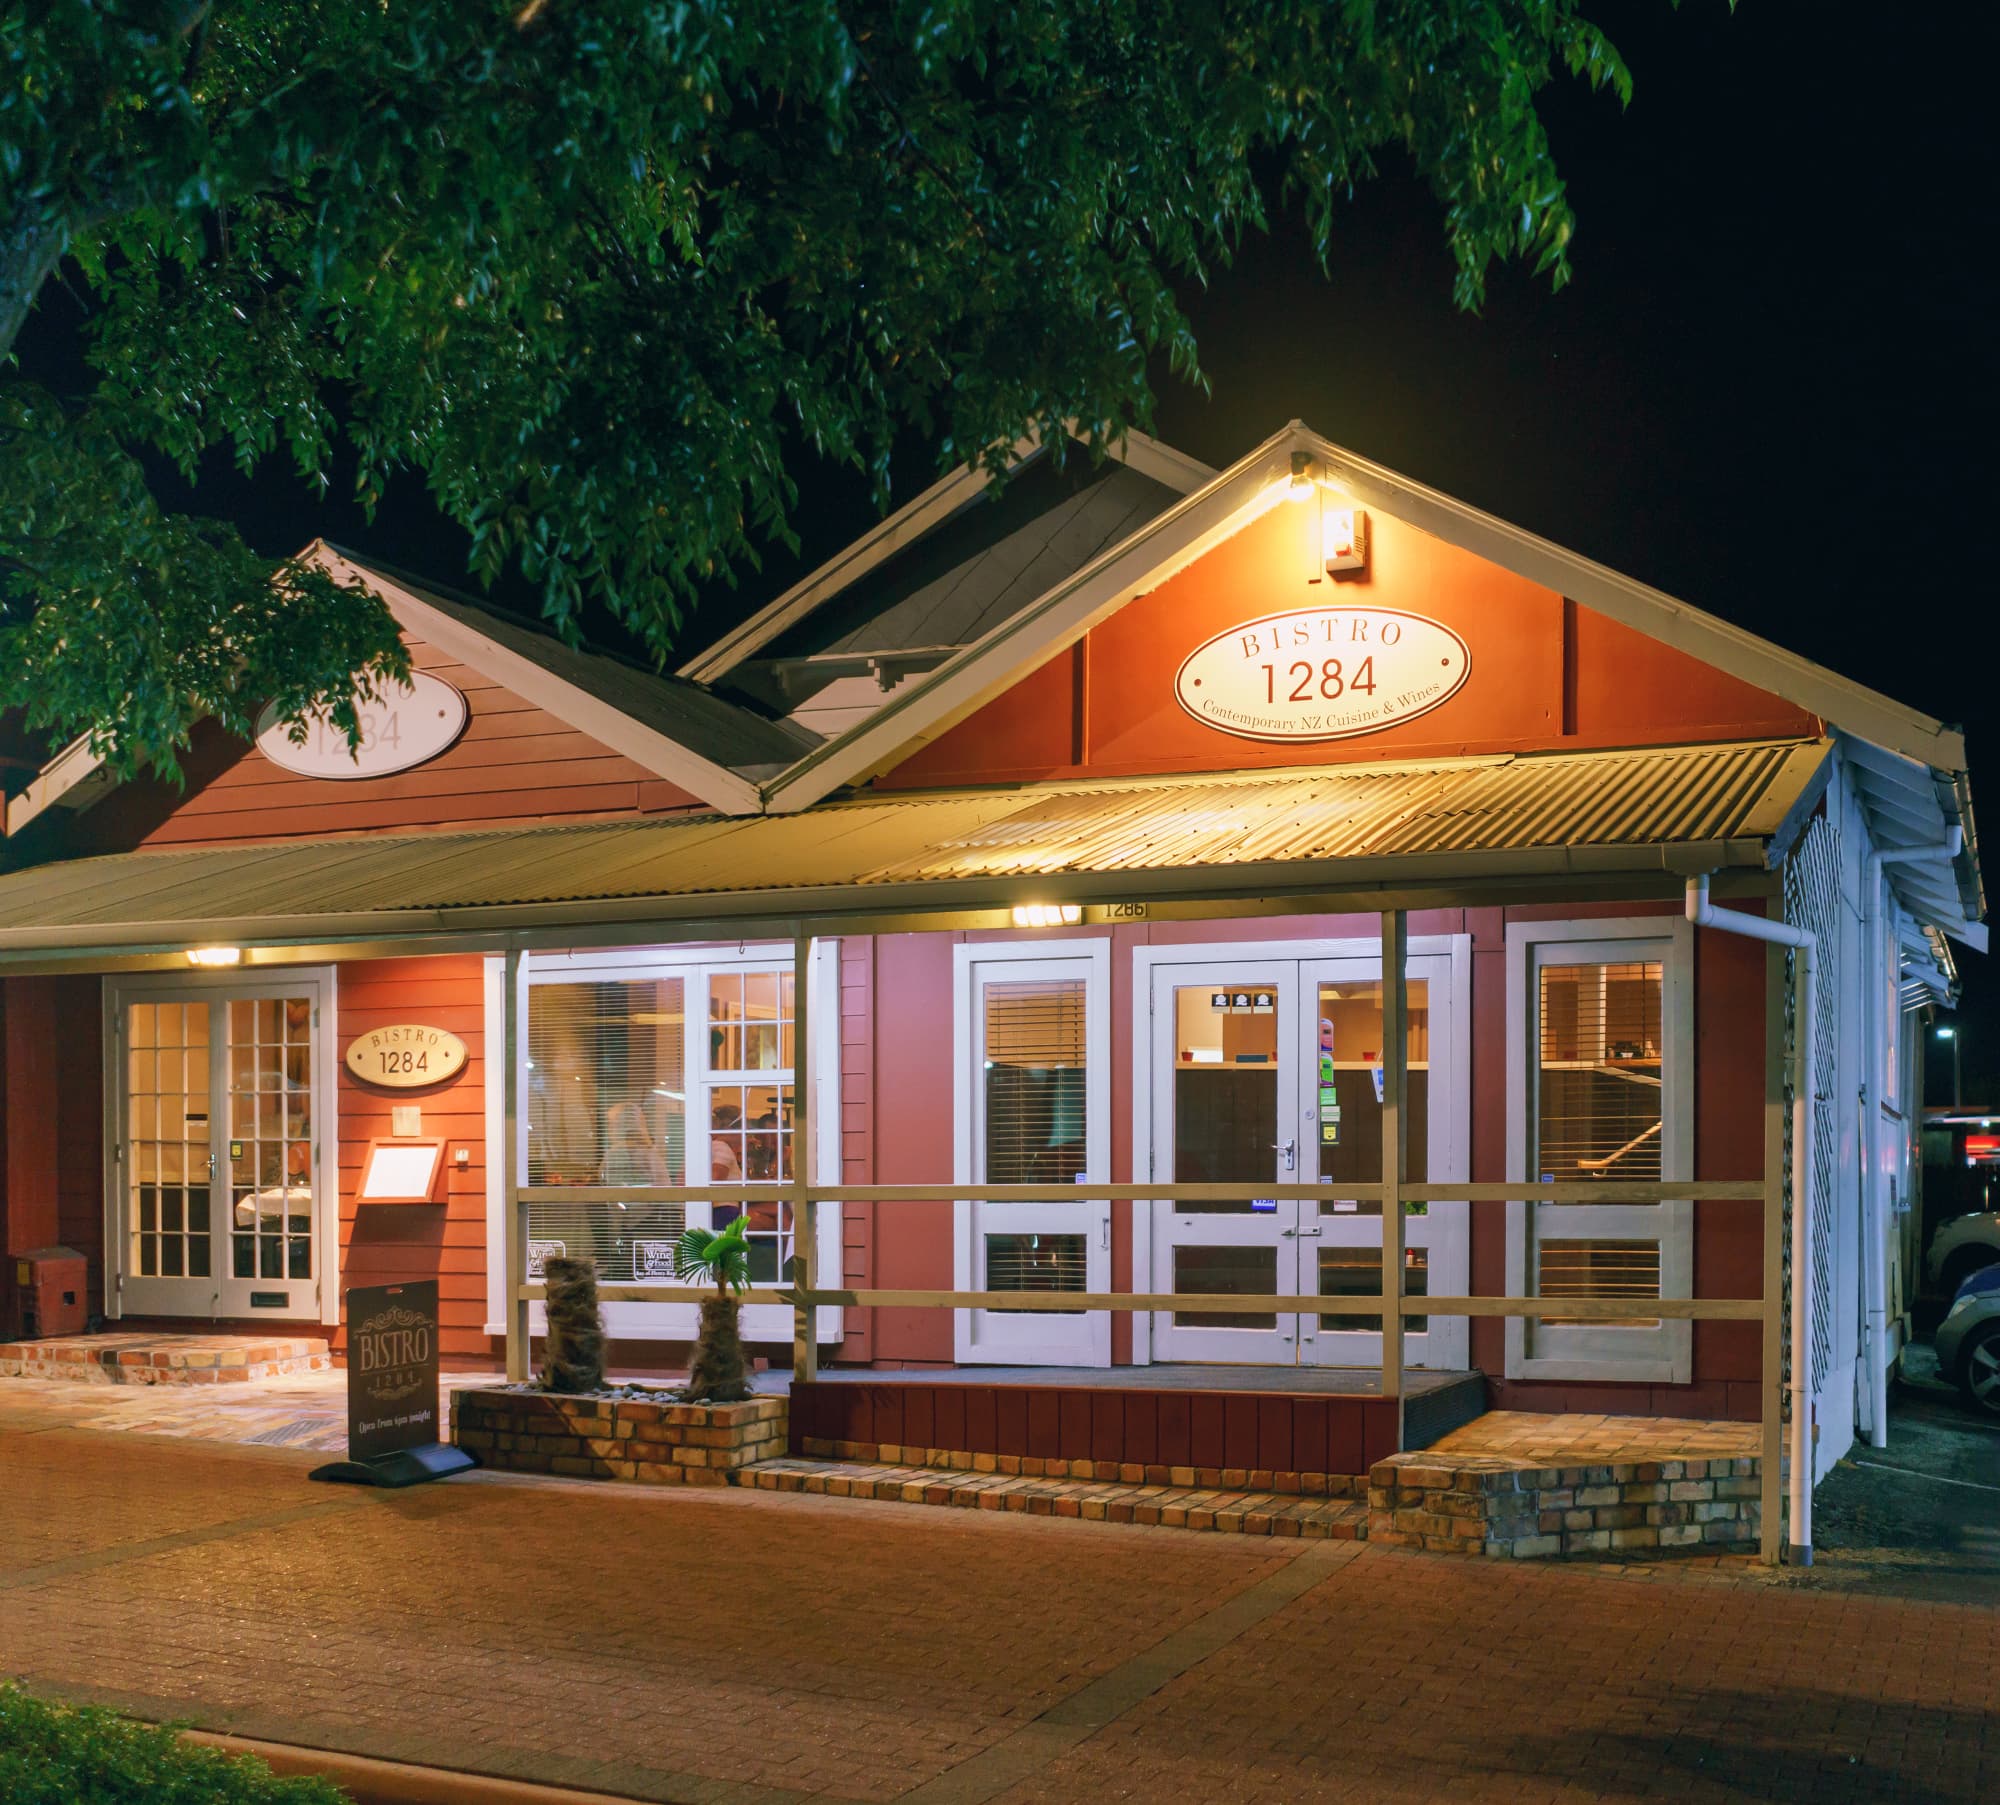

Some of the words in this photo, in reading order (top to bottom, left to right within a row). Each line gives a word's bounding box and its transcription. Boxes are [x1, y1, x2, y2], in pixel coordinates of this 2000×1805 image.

[1240, 618, 1402, 659] BISTRO
[1261, 655, 1377, 704] 1284
[1202, 698, 1297, 732] Contemporary
[1301, 716, 1323, 730] NZ
[1326, 708, 1379, 728] Cuisine
[1383, 701, 1395, 715] &
[1397, 682, 1441, 709] Wines
[1107, 903, 1144, 917] 1286
[371, 1029, 439, 1048] BISTRO
[379, 1051, 428, 1074] 1284
[360, 1328, 429, 1371] BISTRO
